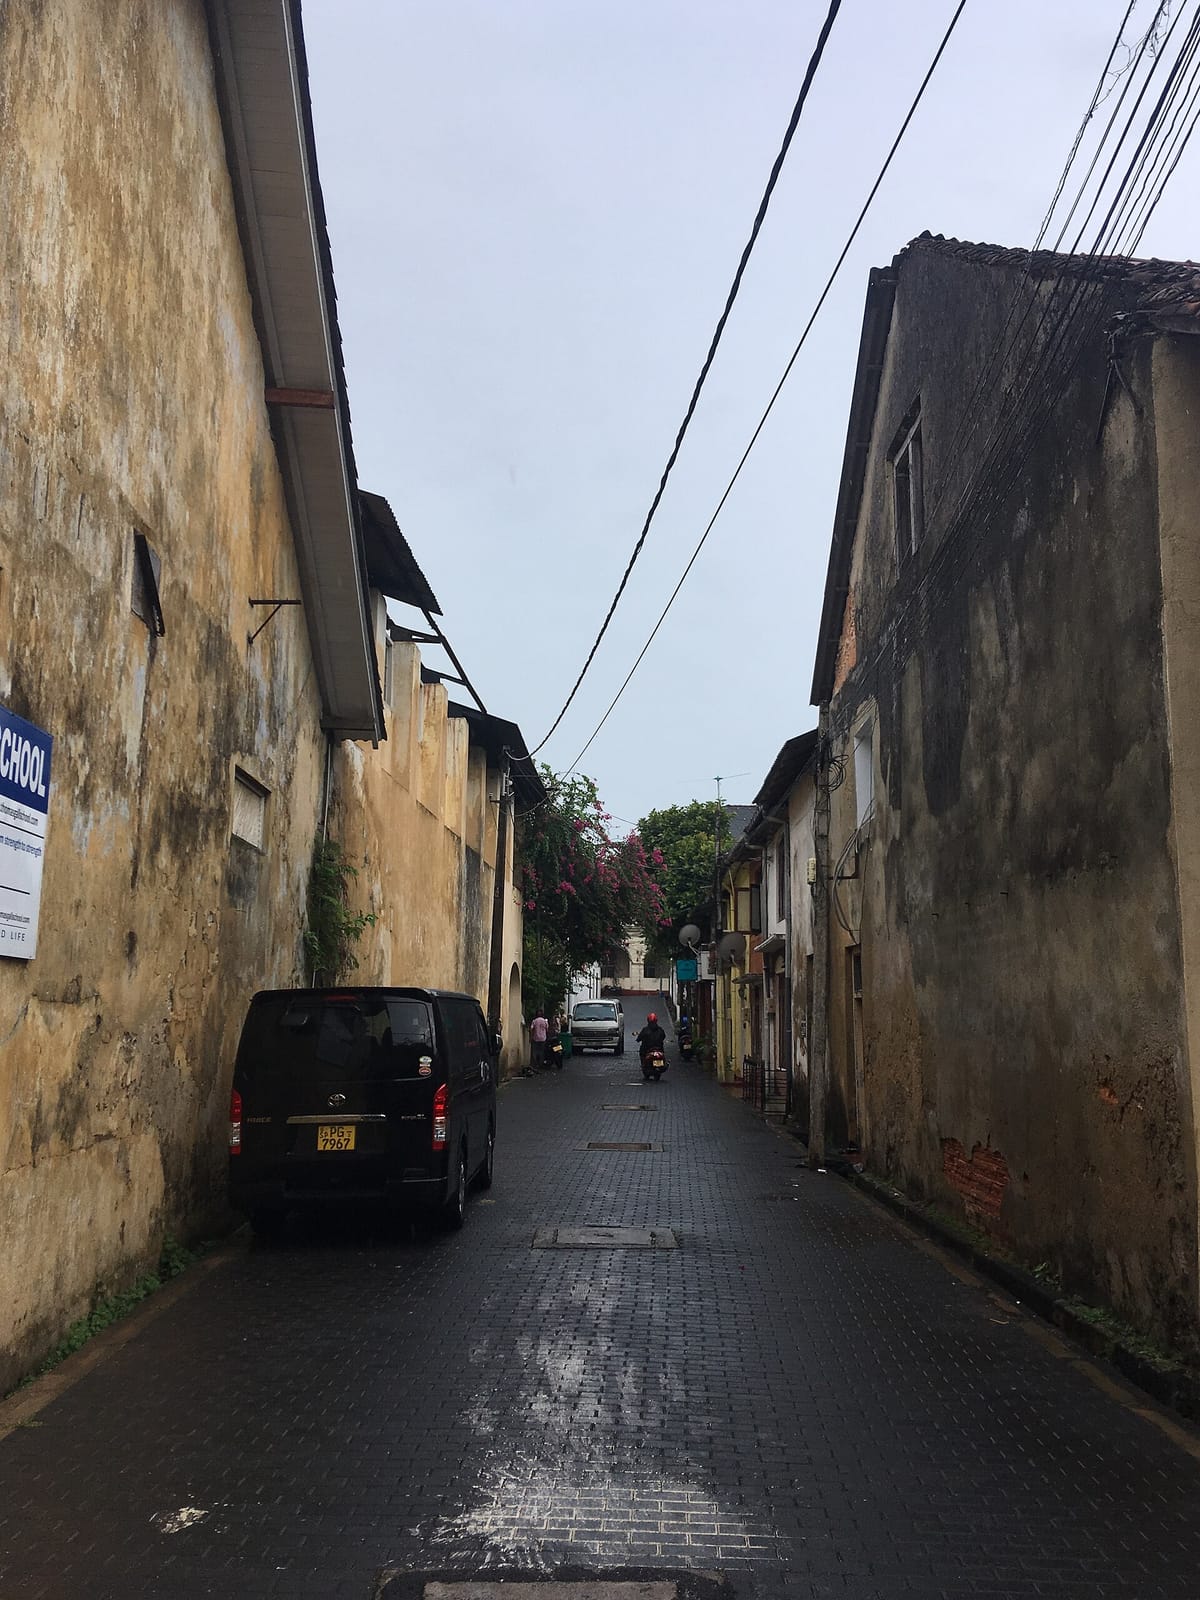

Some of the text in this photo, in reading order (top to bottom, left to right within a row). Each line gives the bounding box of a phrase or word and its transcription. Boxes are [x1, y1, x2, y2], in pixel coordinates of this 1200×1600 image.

[0, 725, 46, 798] CHOOL
[10, 931, 26, 942] LIFE
[330, 1127, 344, 1138] PG
[322, 1138, 351, 1149] 7967
